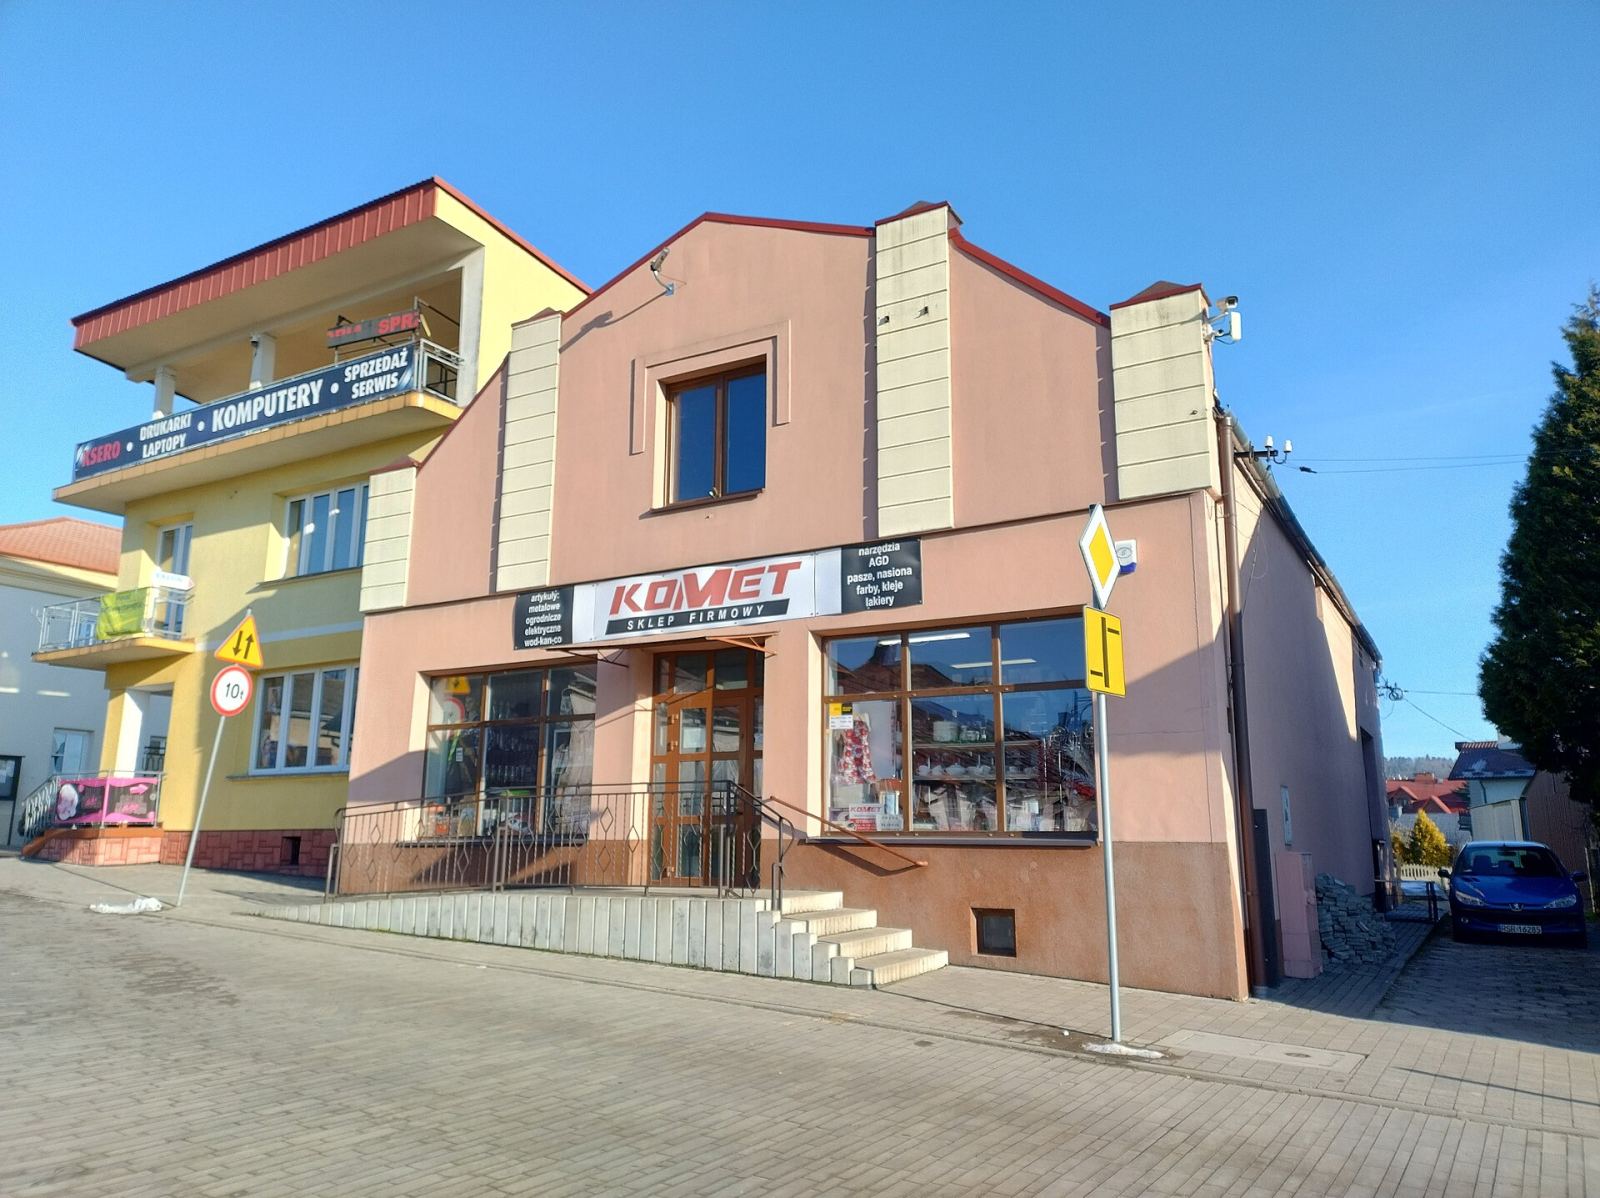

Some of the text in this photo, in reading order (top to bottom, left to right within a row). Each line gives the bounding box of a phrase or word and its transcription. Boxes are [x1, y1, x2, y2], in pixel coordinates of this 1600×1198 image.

[344, 347, 409, 383] SPRZEDAŻ
[351, 372, 399, 399] SERWIS
[212, 378, 324, 433] KOMPUTERY
[140, 412, 193, 441] DRUKARKI
[82, 440, 121, 467] KSERO
[142, 433, 187, 459] LAPTOPY
[858, 542, 901, 556] narzędzia
[868, 555, 890, 568] AGD
[847, 567, 913, 585] pasze, nasiona
[609, 561, 802, 616] KOMET
[856, 579, 904, 596] farby, kleje
[528, 602, 561, 614] metalowe
[865, 595, 895, 607] lakiery
[525, 613, 562, 626] ogrodnicze
[627, 604, 765, 631] SKLEP FIRMOWY
[524, 624, 562, 636] elektryczne
